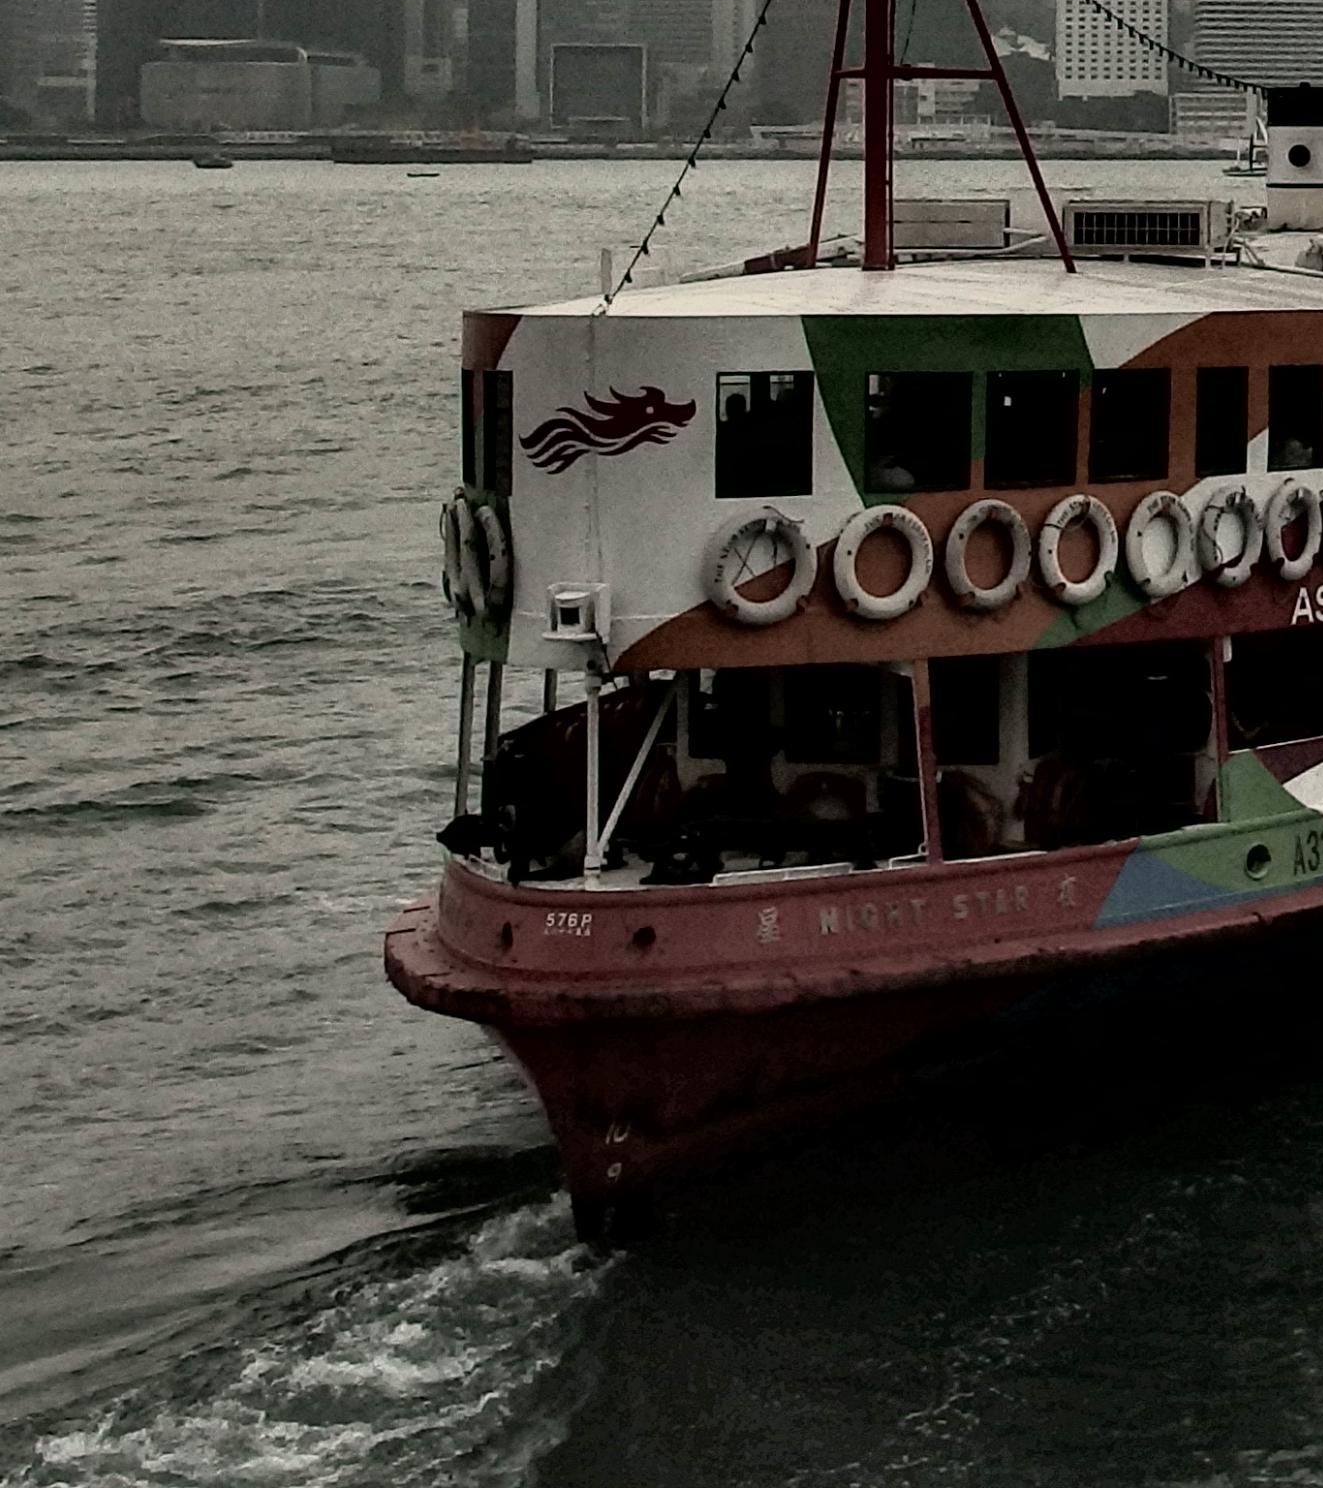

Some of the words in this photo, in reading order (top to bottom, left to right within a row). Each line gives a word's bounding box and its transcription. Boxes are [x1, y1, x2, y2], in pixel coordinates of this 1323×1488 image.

[546, 913, 592, 928] 576P
[819, 898, 926, 936] NIGHT
[953, 885, 1029, 920] STAR
